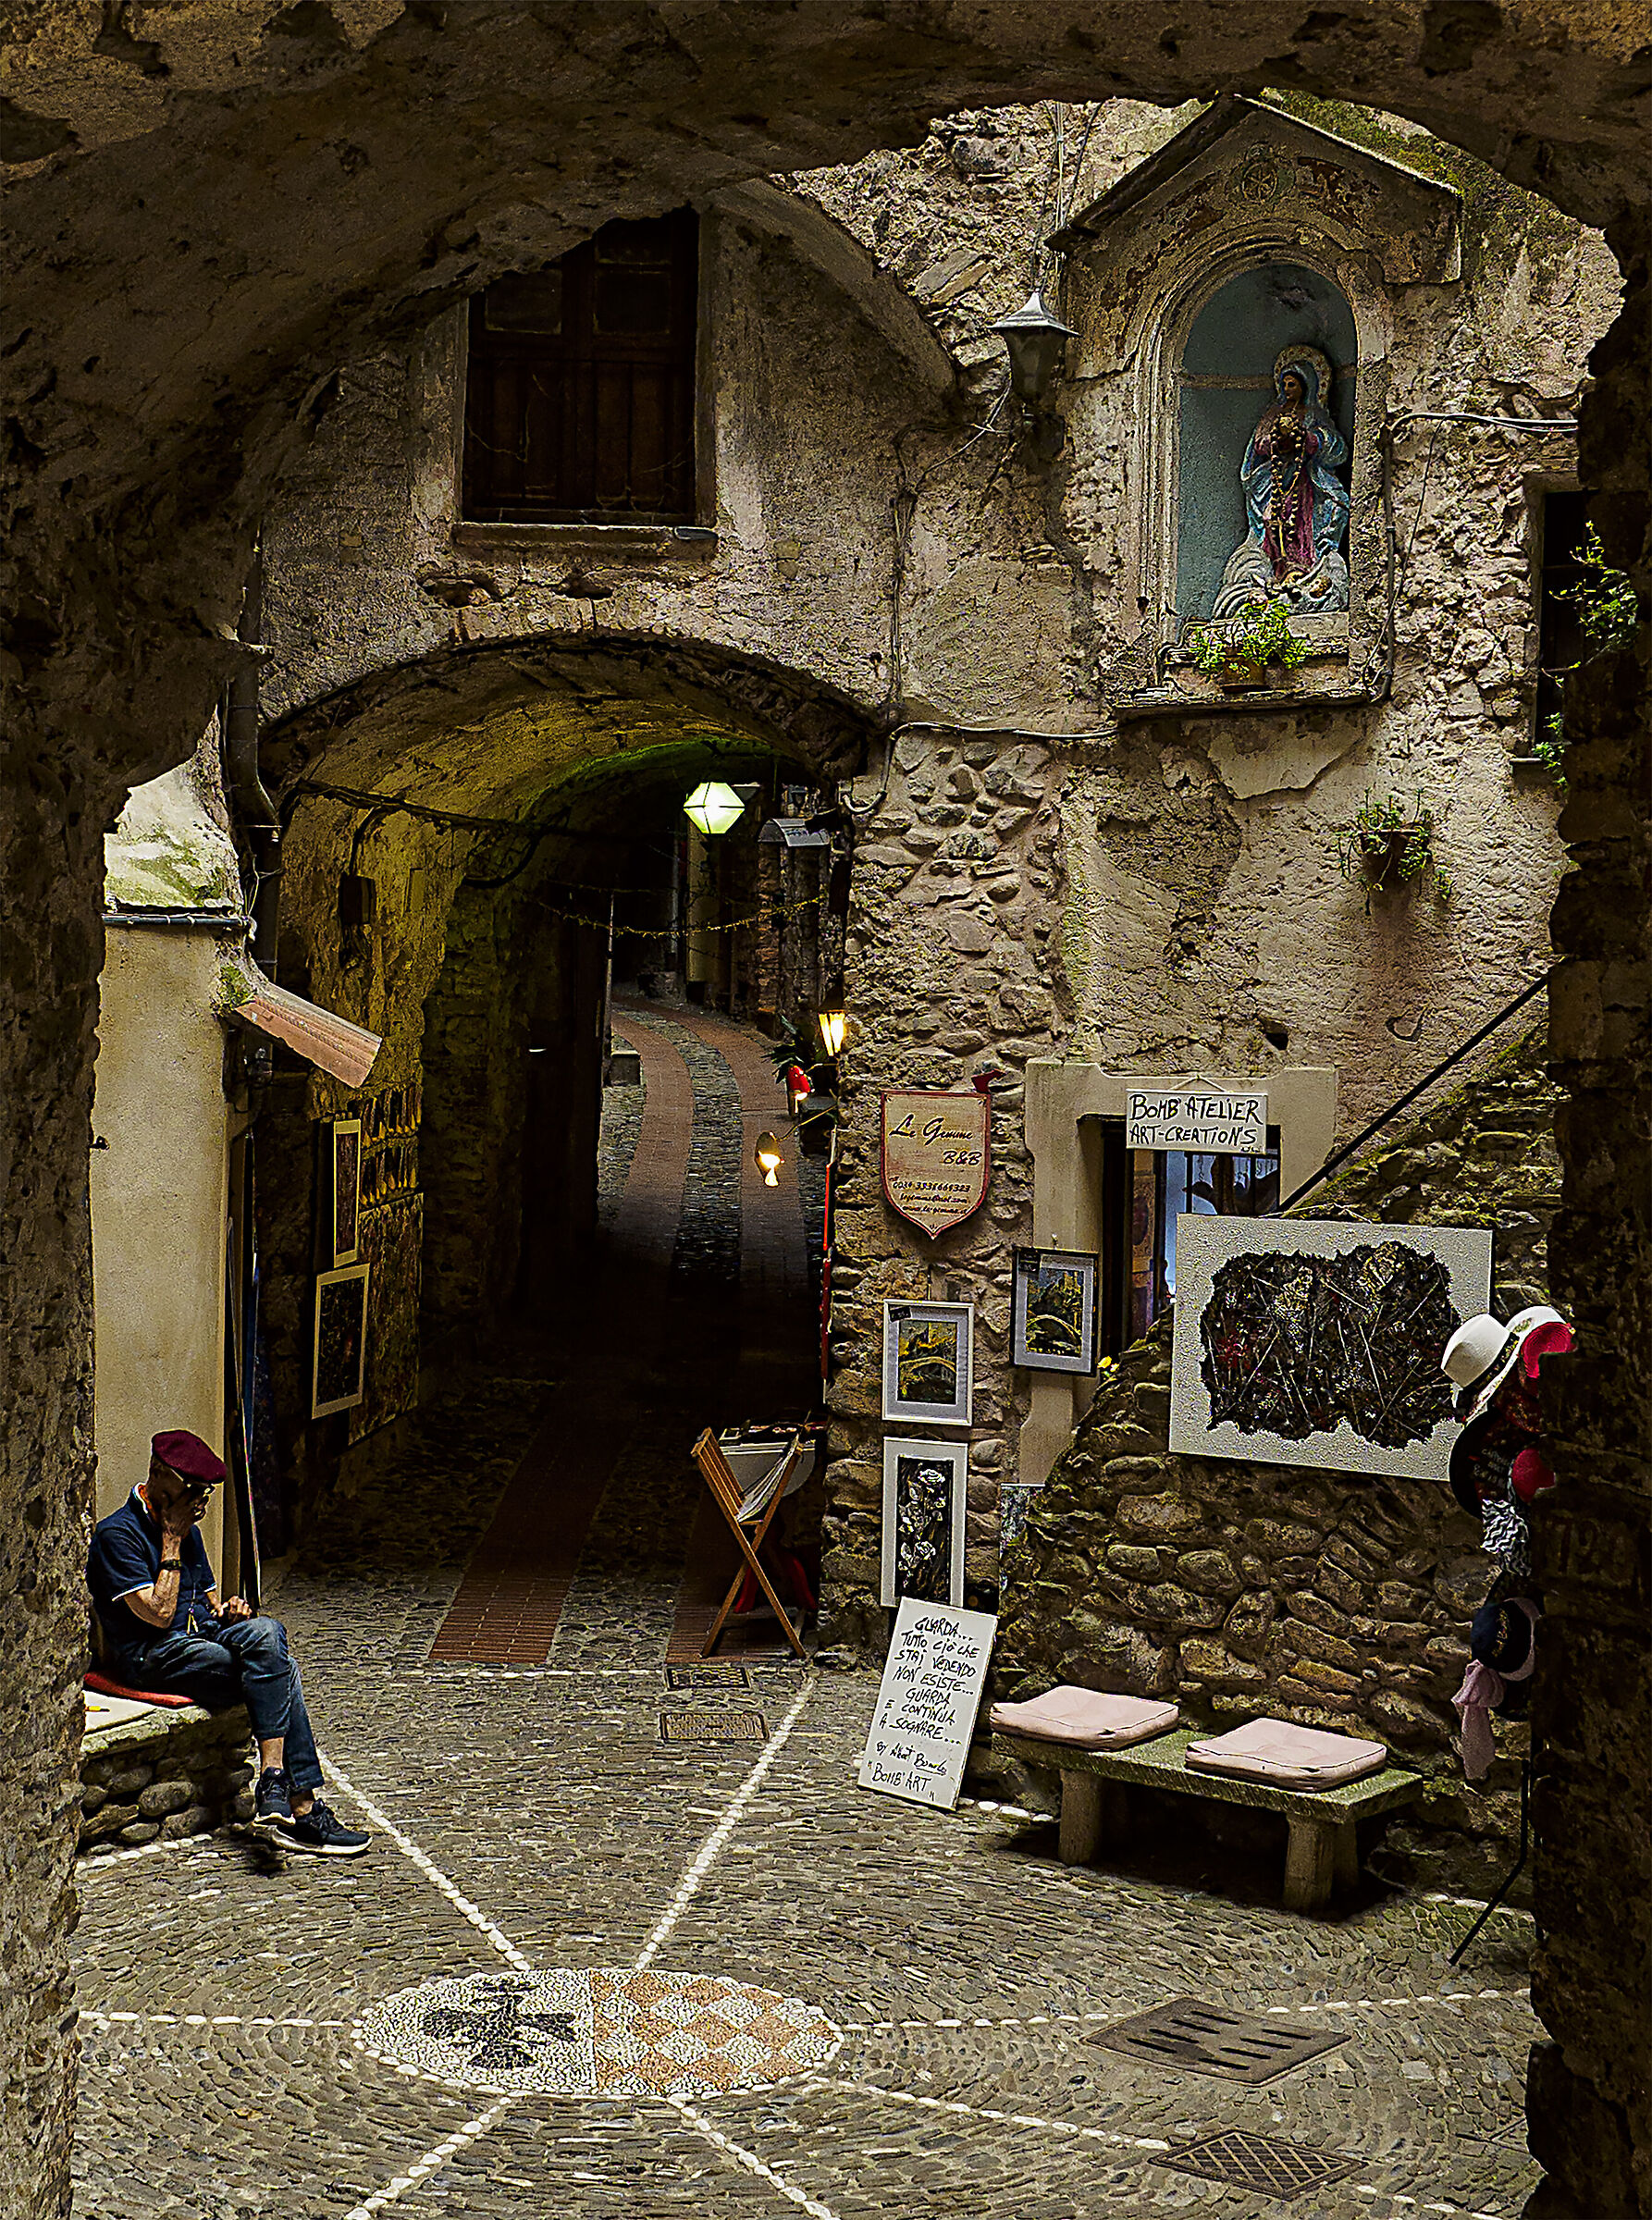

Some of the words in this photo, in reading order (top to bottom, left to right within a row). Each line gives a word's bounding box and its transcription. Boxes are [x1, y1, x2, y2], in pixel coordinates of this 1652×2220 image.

[1185, 1096, 1264, 1125] ATELIER
[889, 1114, 917, 1138] Le
[922, 1117, 973, 1147] Gemme
[943, 1150, 982, 1166] B&B
[901, 1630, 928, 1647] TUTTO
[956, 1644, 980, 1659] CHE
[893, 1665, 922, 1683] NON
[894, 1648, 928, 1666] STAI
[932, 1655, 976, 1677] VEDENDO
[906, 1687, 951, 1708] GUARDA
[879, 1712, 888, 1729] A
[884, 1699, 895, 1709] E
[901, 1703, 956, 1726] CONTINUA
